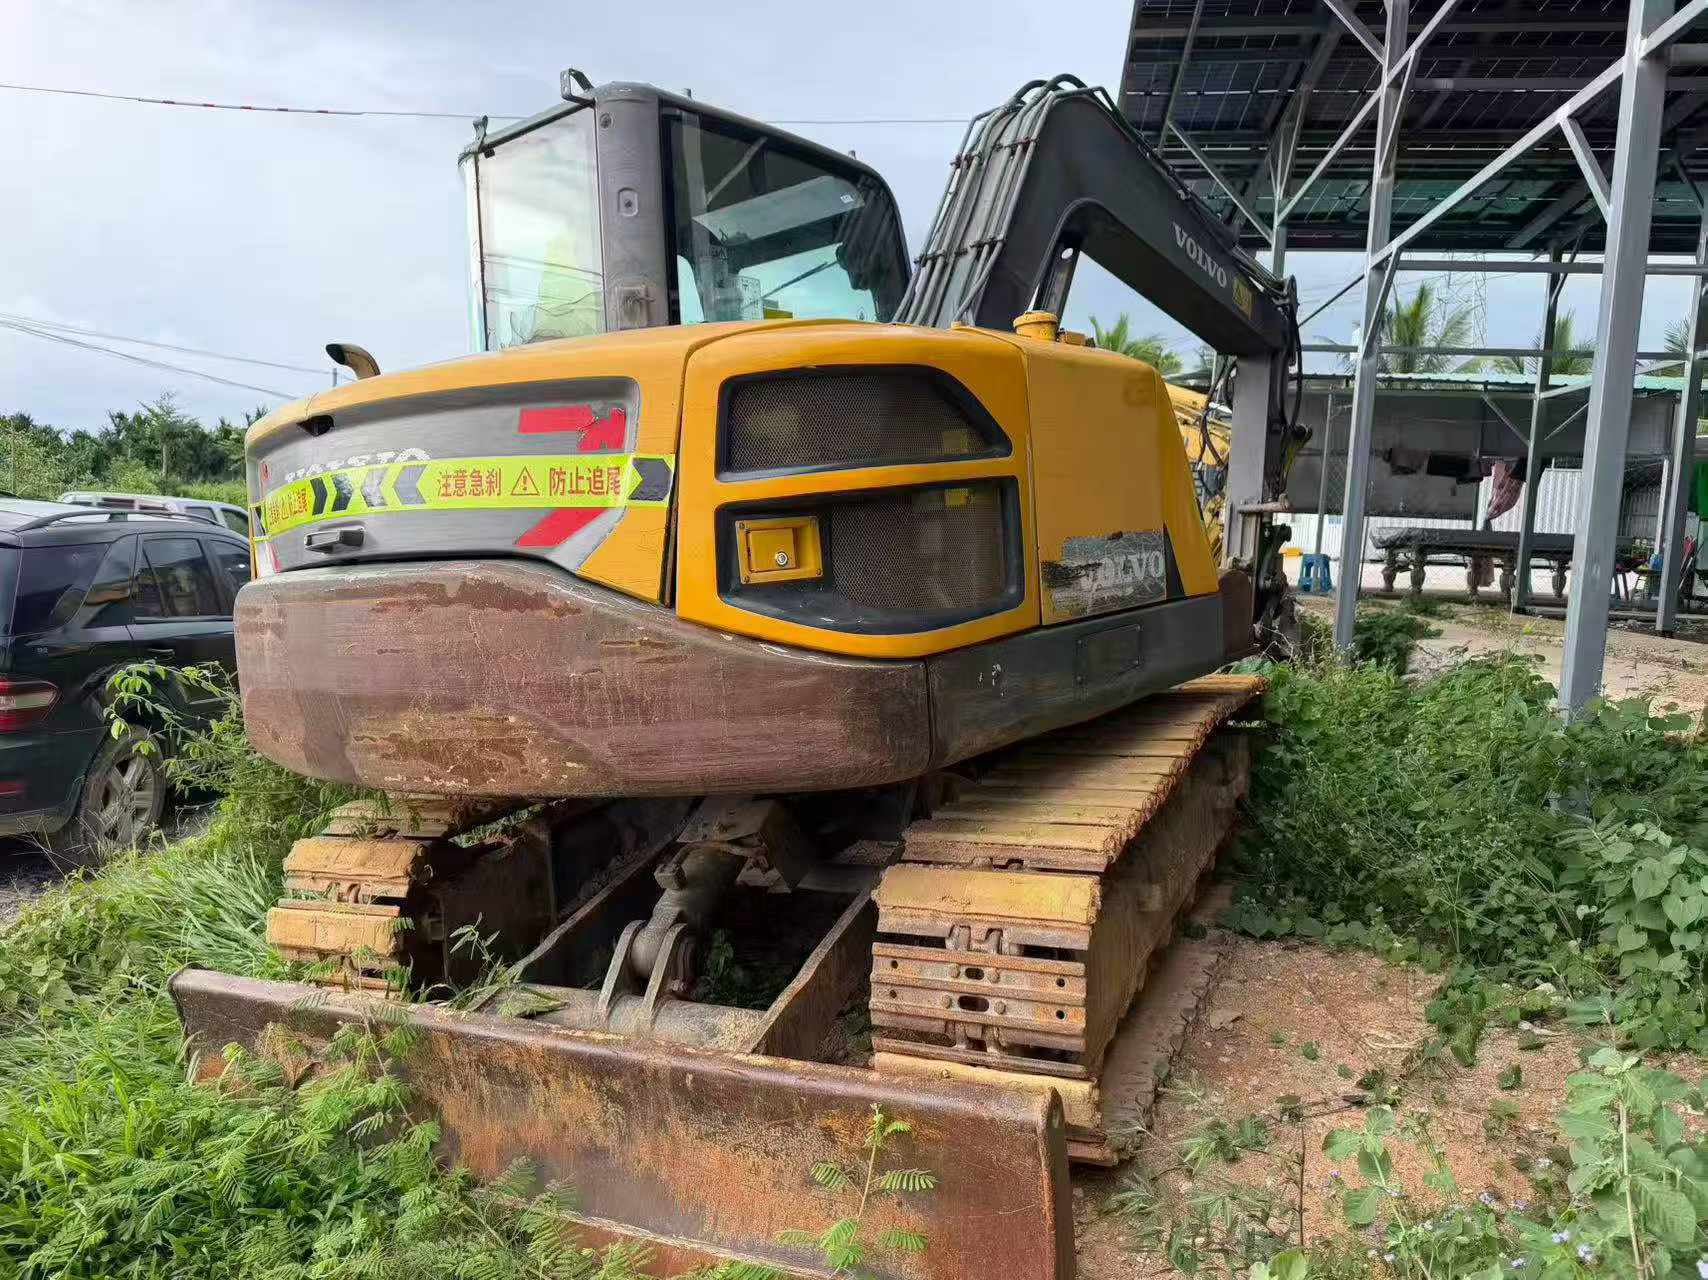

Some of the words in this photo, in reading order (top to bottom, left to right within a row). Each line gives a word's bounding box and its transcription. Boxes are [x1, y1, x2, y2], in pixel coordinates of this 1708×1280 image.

[1173, 221, 1227, 289] VOLVO
[437, 467, 502, 497] 注意急刹
[549, 465, 621, 497] 防止追尾
